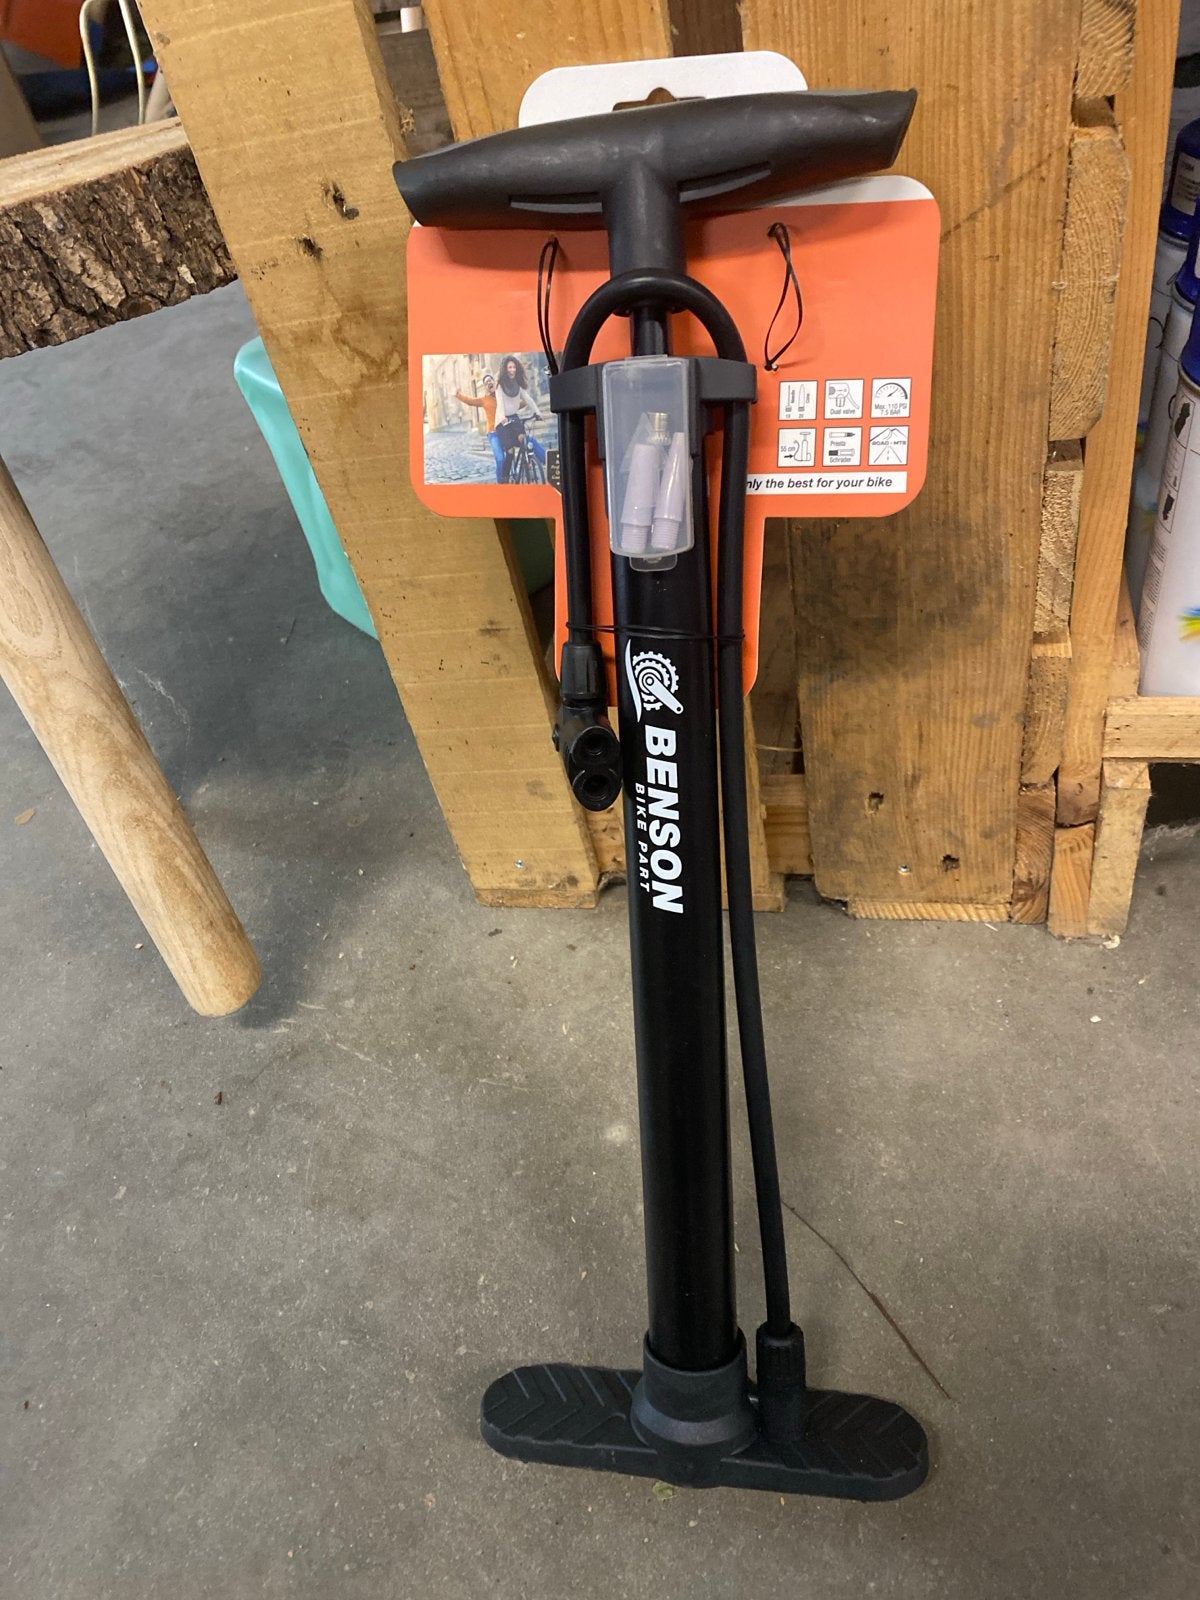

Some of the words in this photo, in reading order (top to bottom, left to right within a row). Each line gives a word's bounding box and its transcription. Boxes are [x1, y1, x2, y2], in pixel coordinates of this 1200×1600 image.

[746, 478, 762, 490] nly
[765, 478, 785, 489] the
[787, 478, 814, 488] best
[816, 477, 834, 488] for
[836, 478, 864, 490] your
[866, 476, 893, 488] bike
[635, 782, 647, 833] BIKE
[644, 724, 684, 914] BENSON
[638, 840, 650, 892] PART
